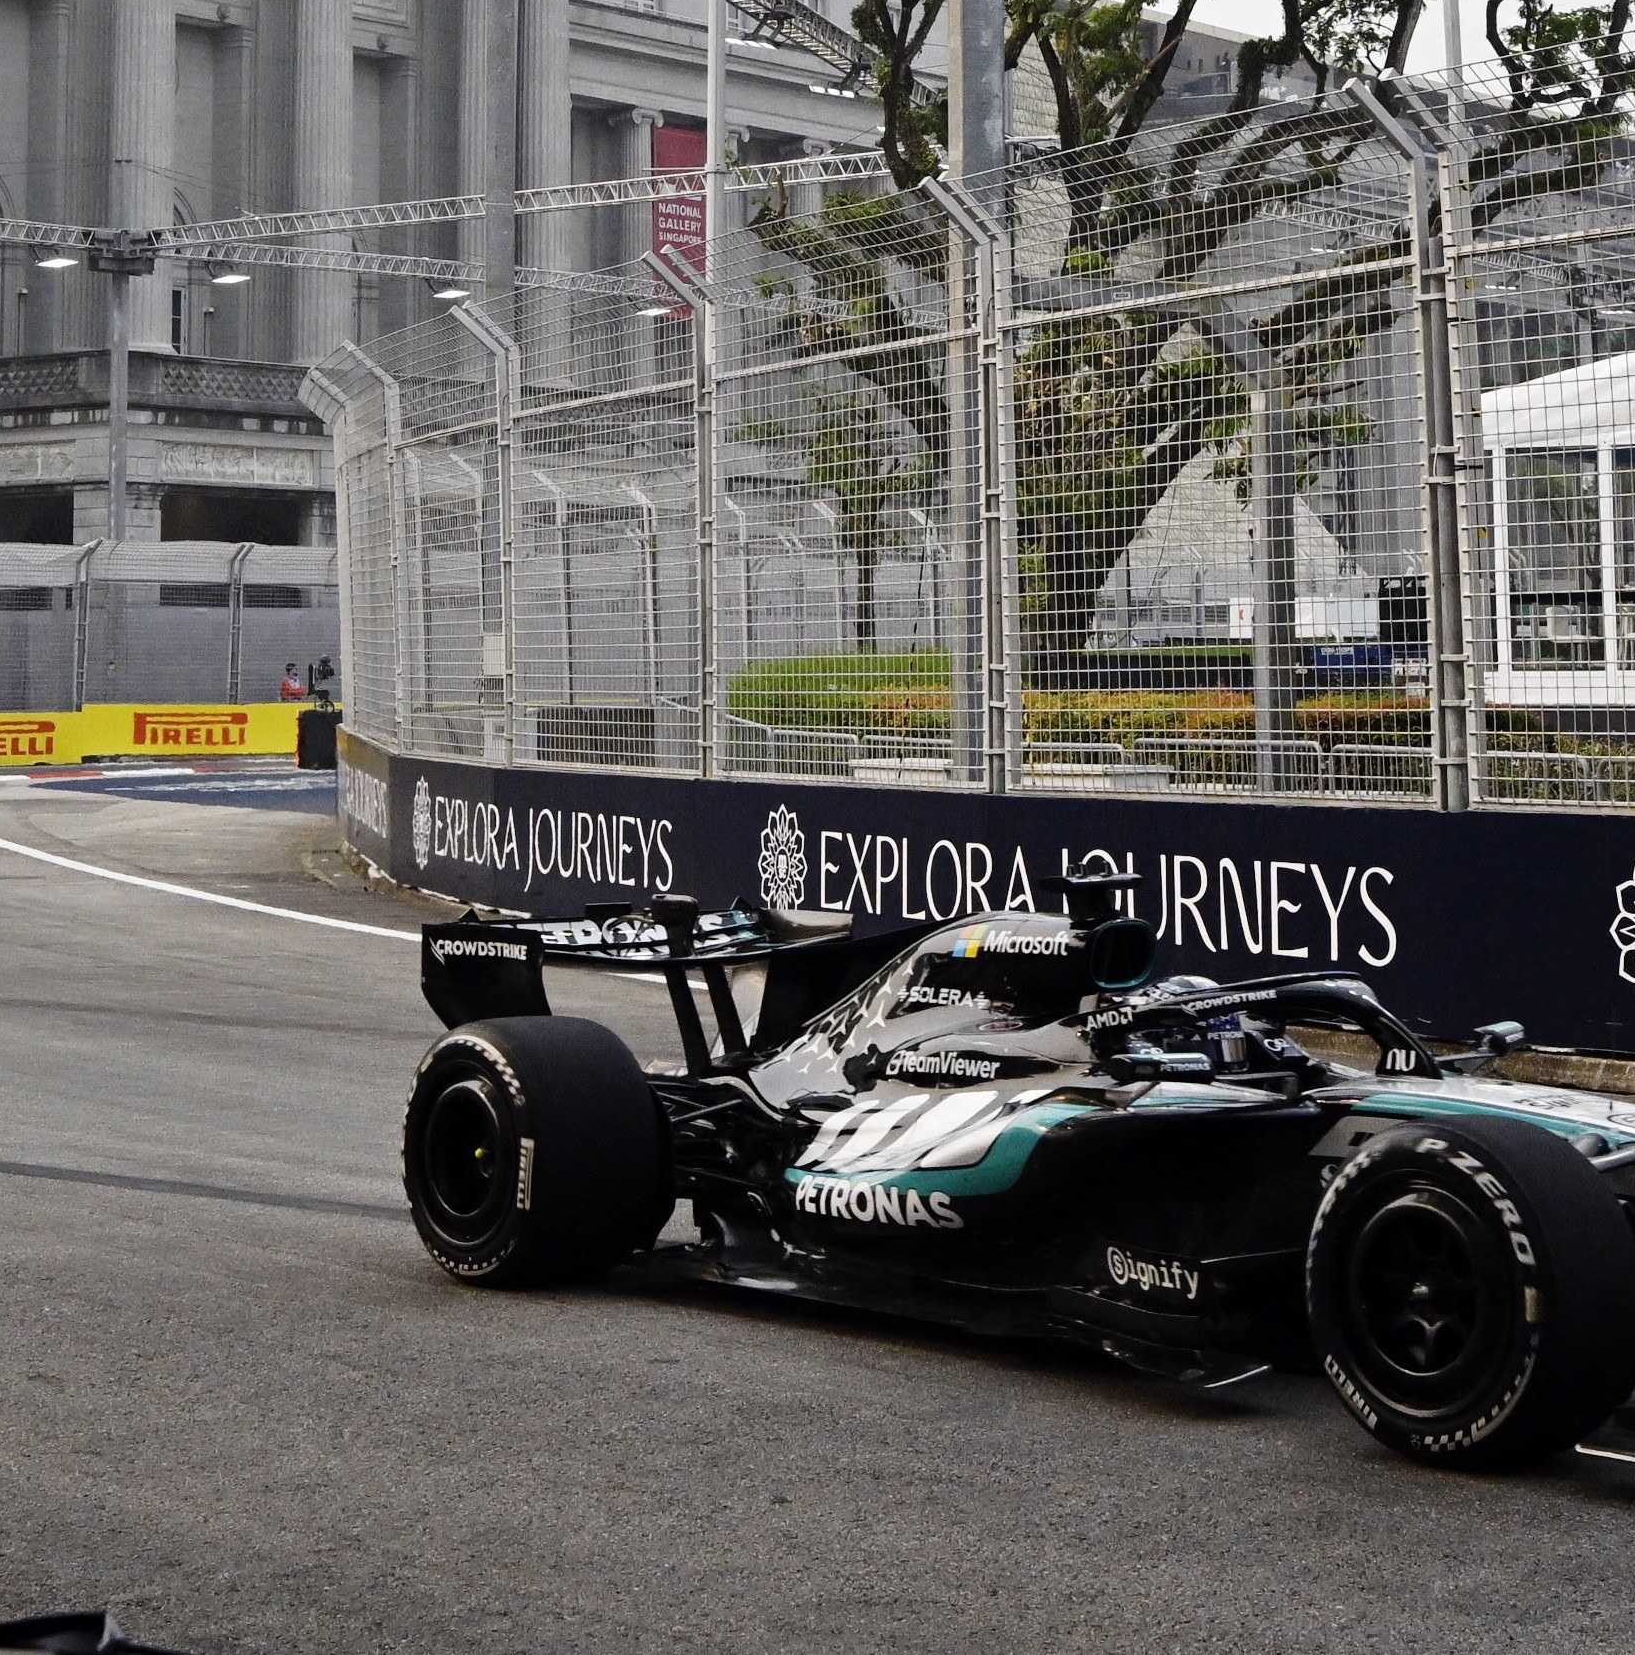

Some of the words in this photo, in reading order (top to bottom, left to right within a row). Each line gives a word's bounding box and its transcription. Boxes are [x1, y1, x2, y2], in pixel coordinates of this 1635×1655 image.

[658, 203, 702, 218] NATIONAL
[658, 217, 702, 234] GALLERY
[658, 231, 702, 244] SINGAPORE
[133, 712, 248, 746] PIRELLI
[434, 796, 519, 871] EXPLORA
[523, 808, 674, 893] JOURNEYS
[821, 831, 1036, 921] EXPLORA
[437, 939, 528, 961] CROWDSTRIKE
[983, 929, 1069, 957] Microsoft
[910, 985, 973, 1007] SOLERA
[1186, 989, 1278, 1012] CROWDSTRIKE
[1085, 1012, 1120, 1032] AMD
[899, 1049, 1000, 1079] TeamViewer
[1160, 1062, 1211, 1073] PETRONAS
[795, 1175, 965, 1230] PETRONAS
[1448, 1150, 1537, 1266] ZERO
[1323, 1352, 1378, 1431] PIRELLI
